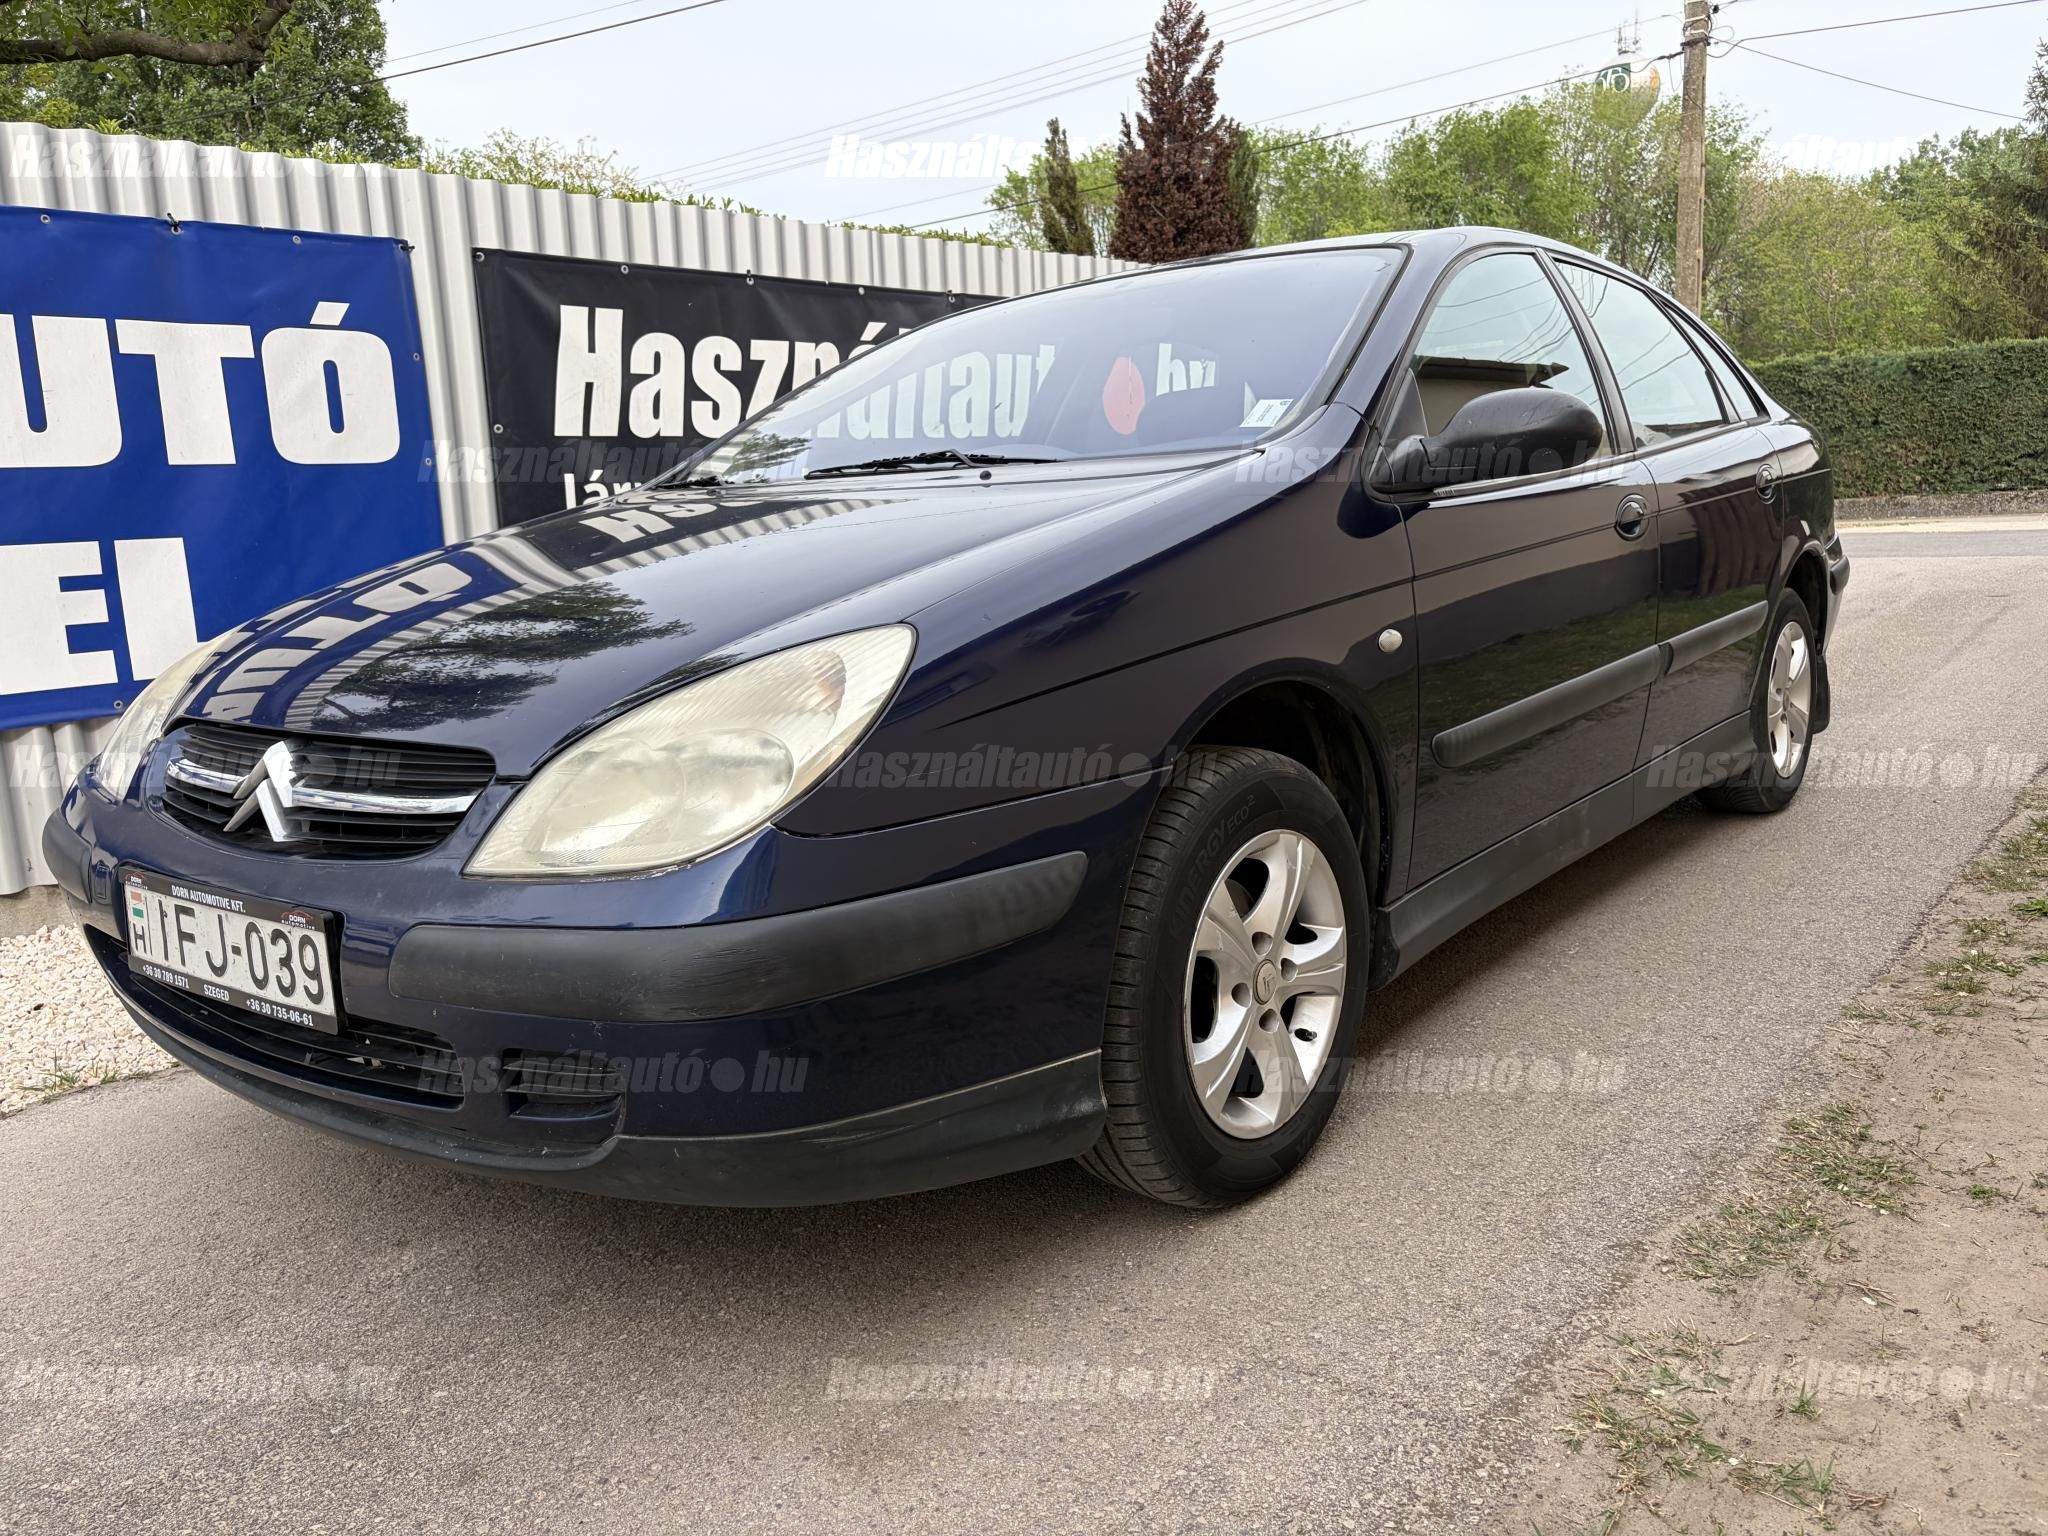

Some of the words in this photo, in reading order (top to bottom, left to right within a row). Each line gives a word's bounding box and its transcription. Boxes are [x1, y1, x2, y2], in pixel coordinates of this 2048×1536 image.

[171, 884, 189, 900] DORN
[190, 889, 230, 910] AUTOMOTIVE
[231, 899, 246, 913] KFT.
[174, 974, 189, 989] 1571
[203, 984, 230, 1002] SZEGED
[246, 998, 260, 1011] +36
[260, 1002, 271, 1015] 30
[272, 1005, 314, 1027] 735-06-61
